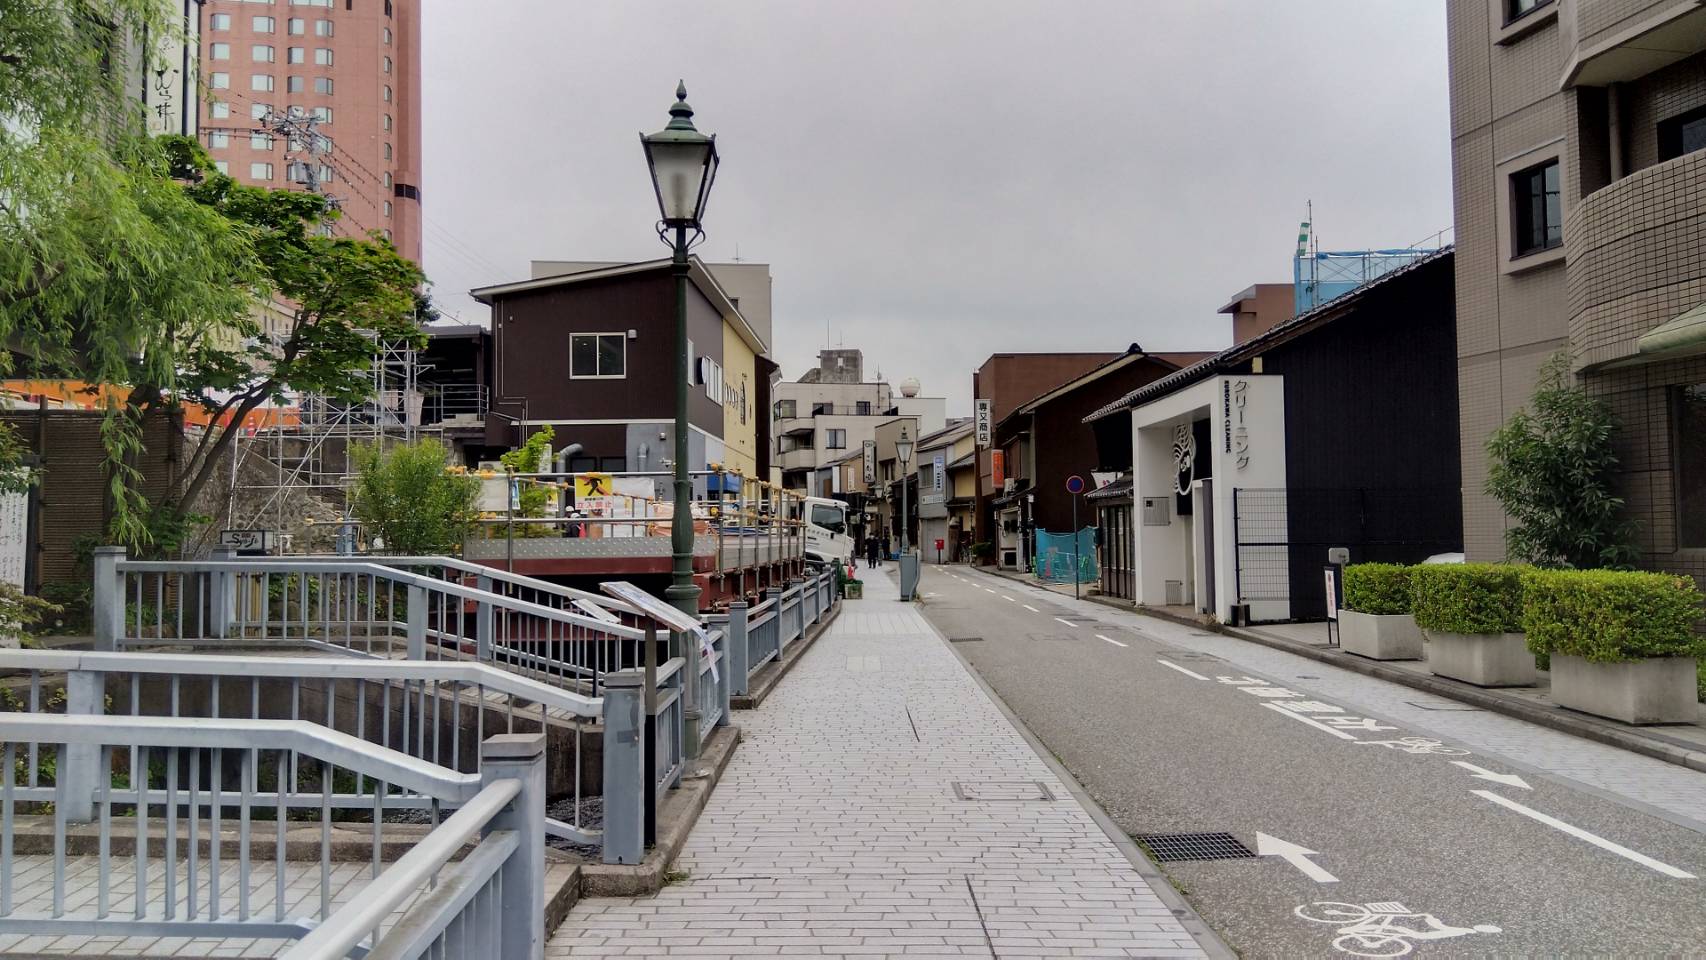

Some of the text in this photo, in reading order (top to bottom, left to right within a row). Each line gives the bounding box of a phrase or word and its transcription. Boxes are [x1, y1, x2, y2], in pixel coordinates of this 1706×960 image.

[1234, 380, 1249, 470] クリーニング
